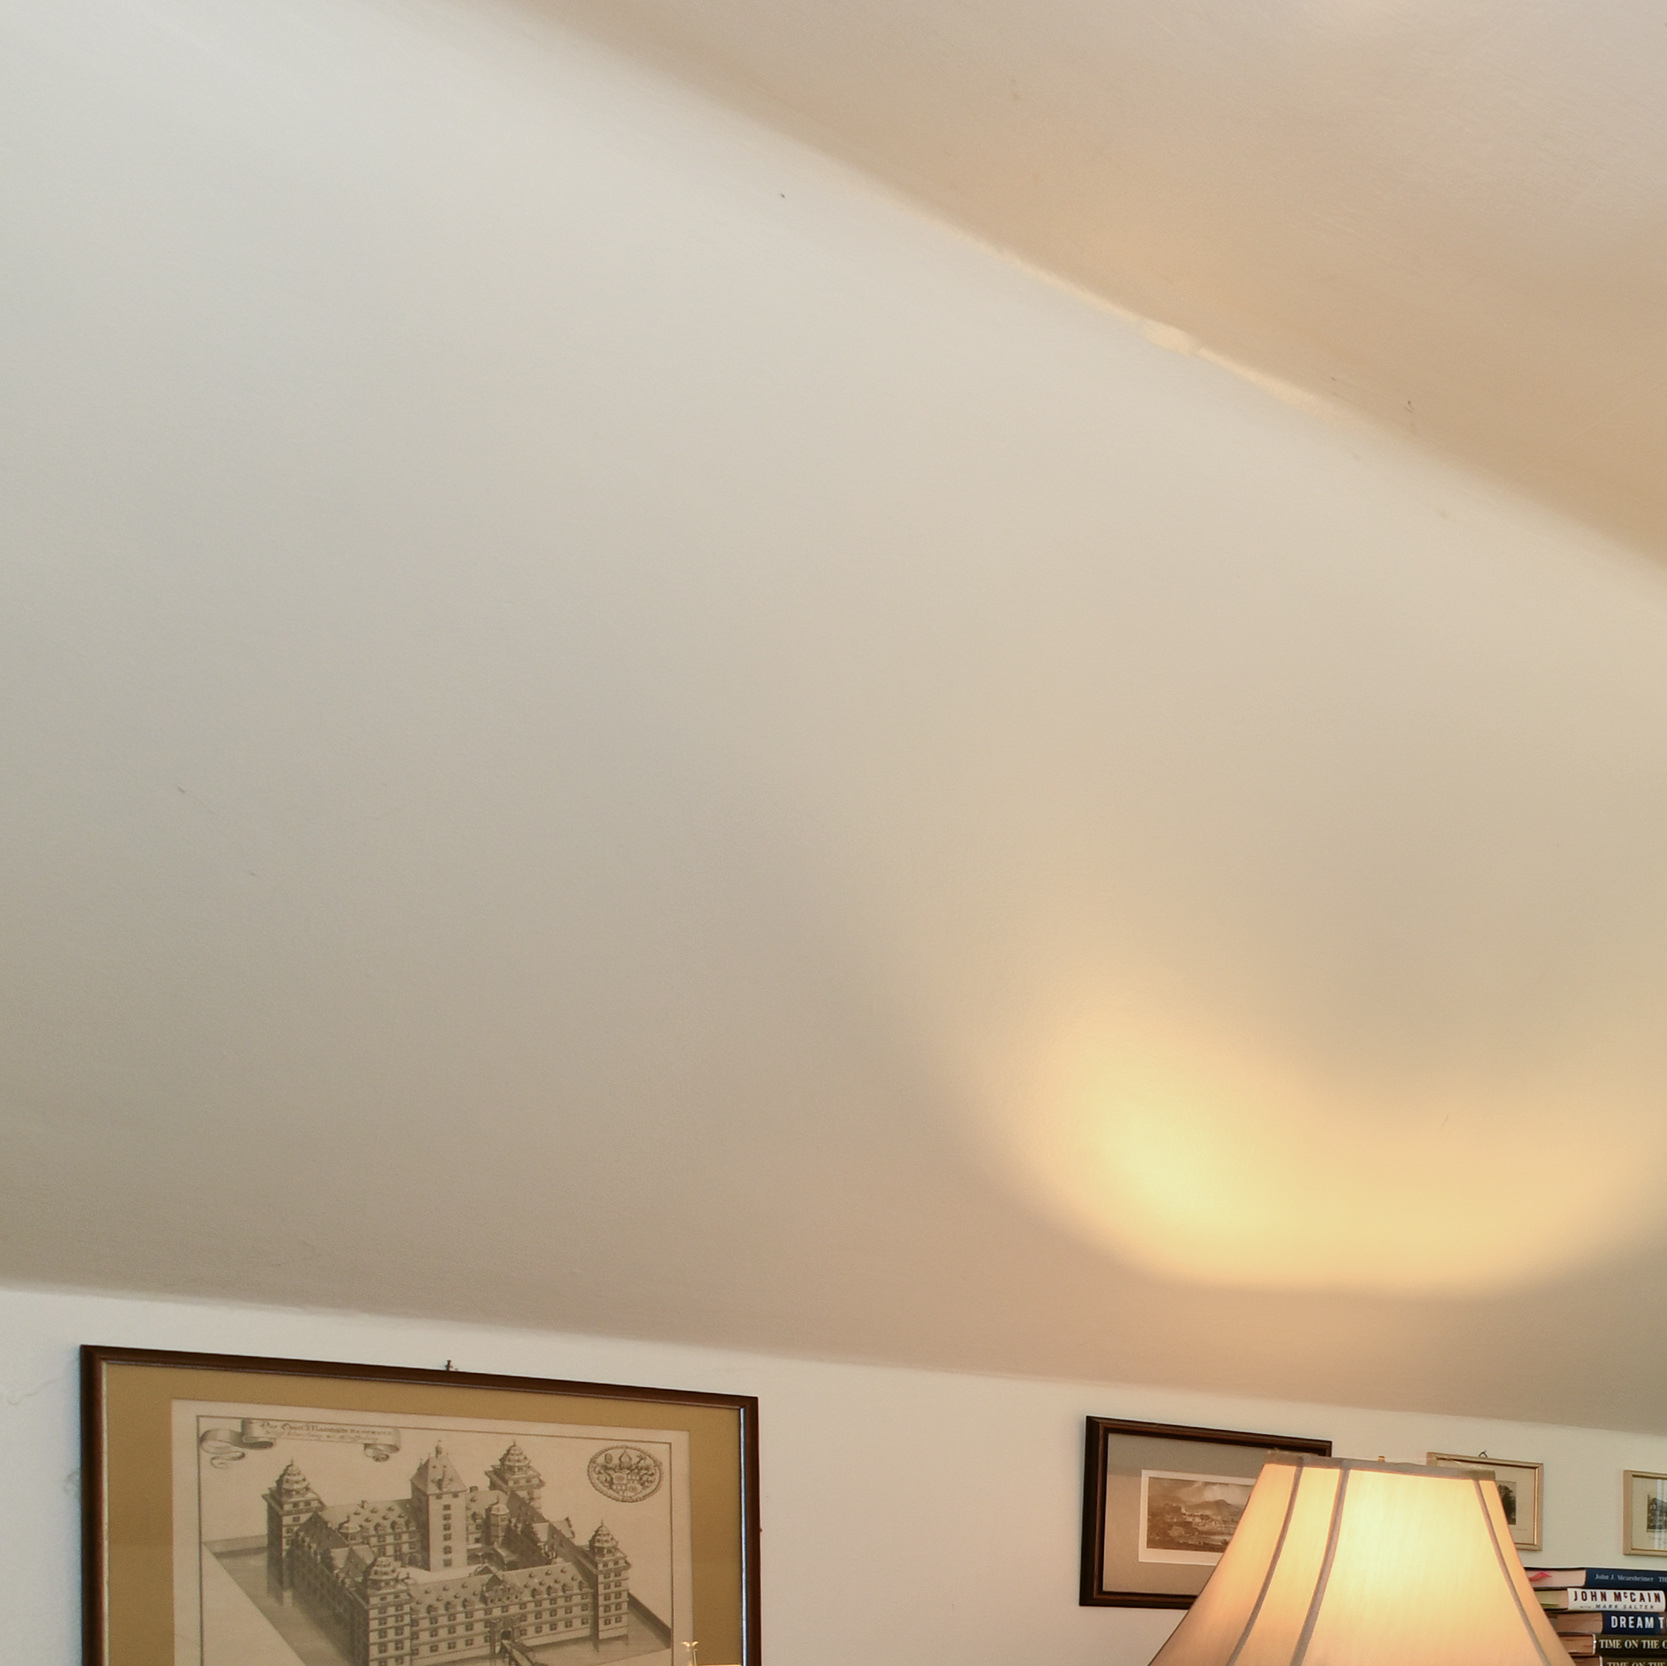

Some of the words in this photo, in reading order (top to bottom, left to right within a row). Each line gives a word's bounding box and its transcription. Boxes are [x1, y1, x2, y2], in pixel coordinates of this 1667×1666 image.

[1573, 1590, 1607, 1602] JOHN
[1613, 1591, 1661, 1603] McCAIN
[1610, 1615, 1654, 1629] DREAM
[1599, 1639, 1621, 1649] TIME
[1624, 1639, 1639, 1649] ON
[1641, 1639, 1661, 1649] THE
